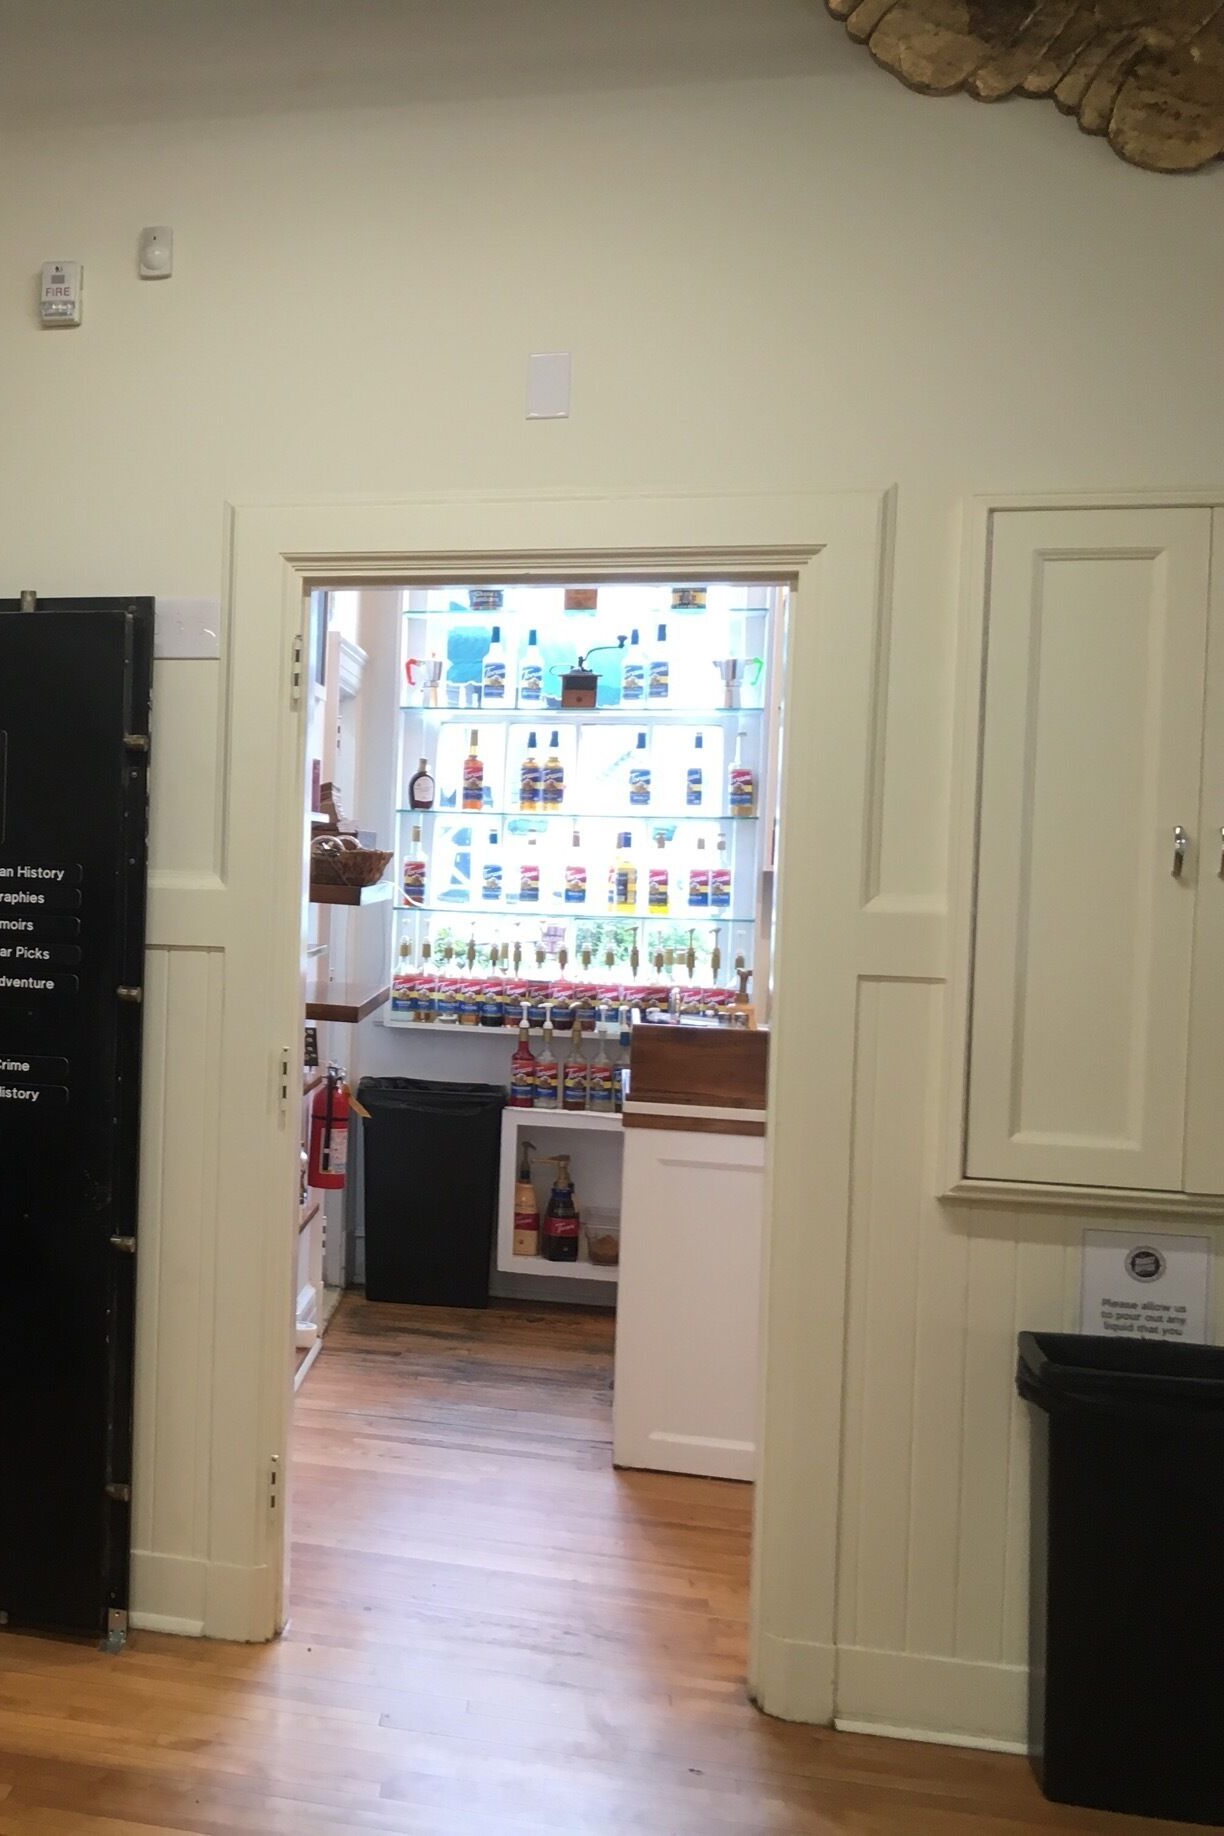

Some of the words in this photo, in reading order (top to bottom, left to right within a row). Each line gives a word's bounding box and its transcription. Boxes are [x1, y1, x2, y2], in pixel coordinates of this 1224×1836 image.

[45, 287, 70, 297] FIRE
[17, 865, 65, 881] History
[16, 946, 50, 960] Picks
[1102, 1298, 1138, 1310] Please
[1142, 1301, 1170, 1312] allow
[1101, 1311, 1113, 1319] to
[1116, 1313, 1140, 1322] pour
[1167, 1317, 1186, 1326] any
[1104, 1321, 1134, 1333] liquid
